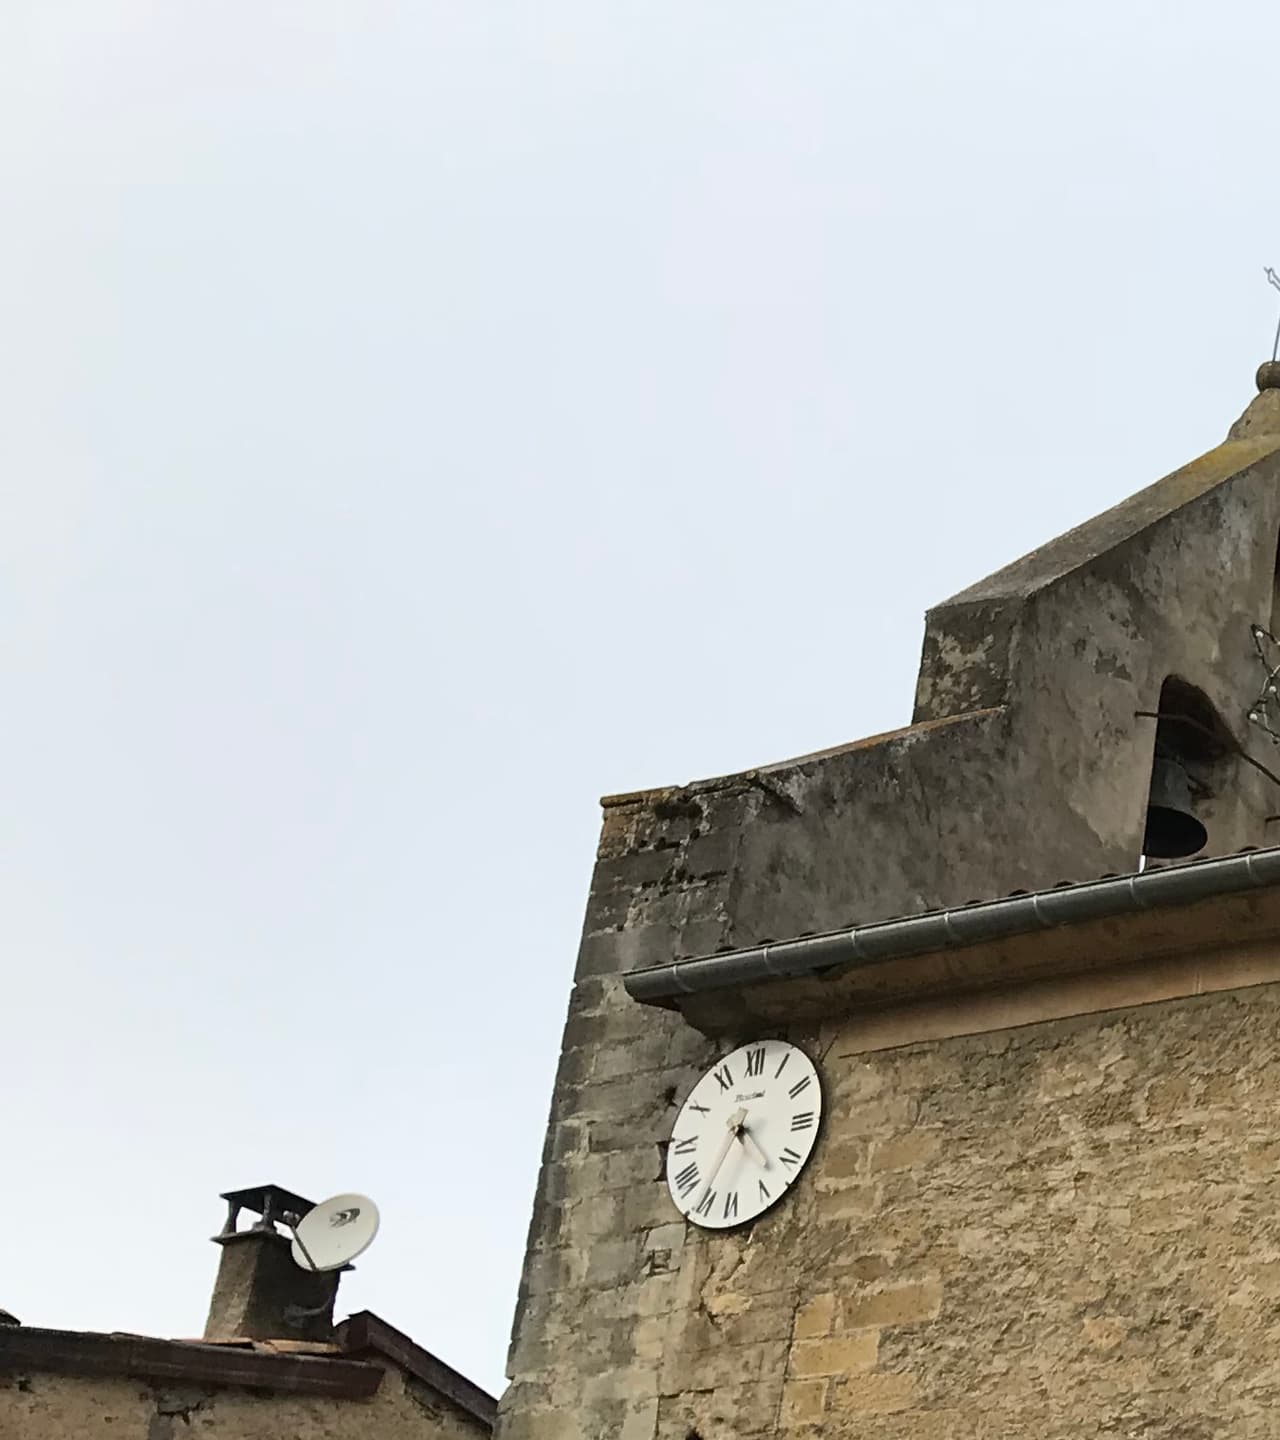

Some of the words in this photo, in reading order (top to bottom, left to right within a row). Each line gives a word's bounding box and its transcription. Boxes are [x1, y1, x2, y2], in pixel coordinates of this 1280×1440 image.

[745, 1047, 765, 1078] XII
[714, 1065, 734, 1095] XI
[789, 1076, 811, 1099] II
[791, 1112, 814, 1132] III
[675, 1136, 699, 1155] IX
[779, 1148, 801, 1171] IV
[675, 1162, 701, 1199] VIII
[691, 1188, 717, 1218] VI
[724, 1192, 738, 1219] VI
